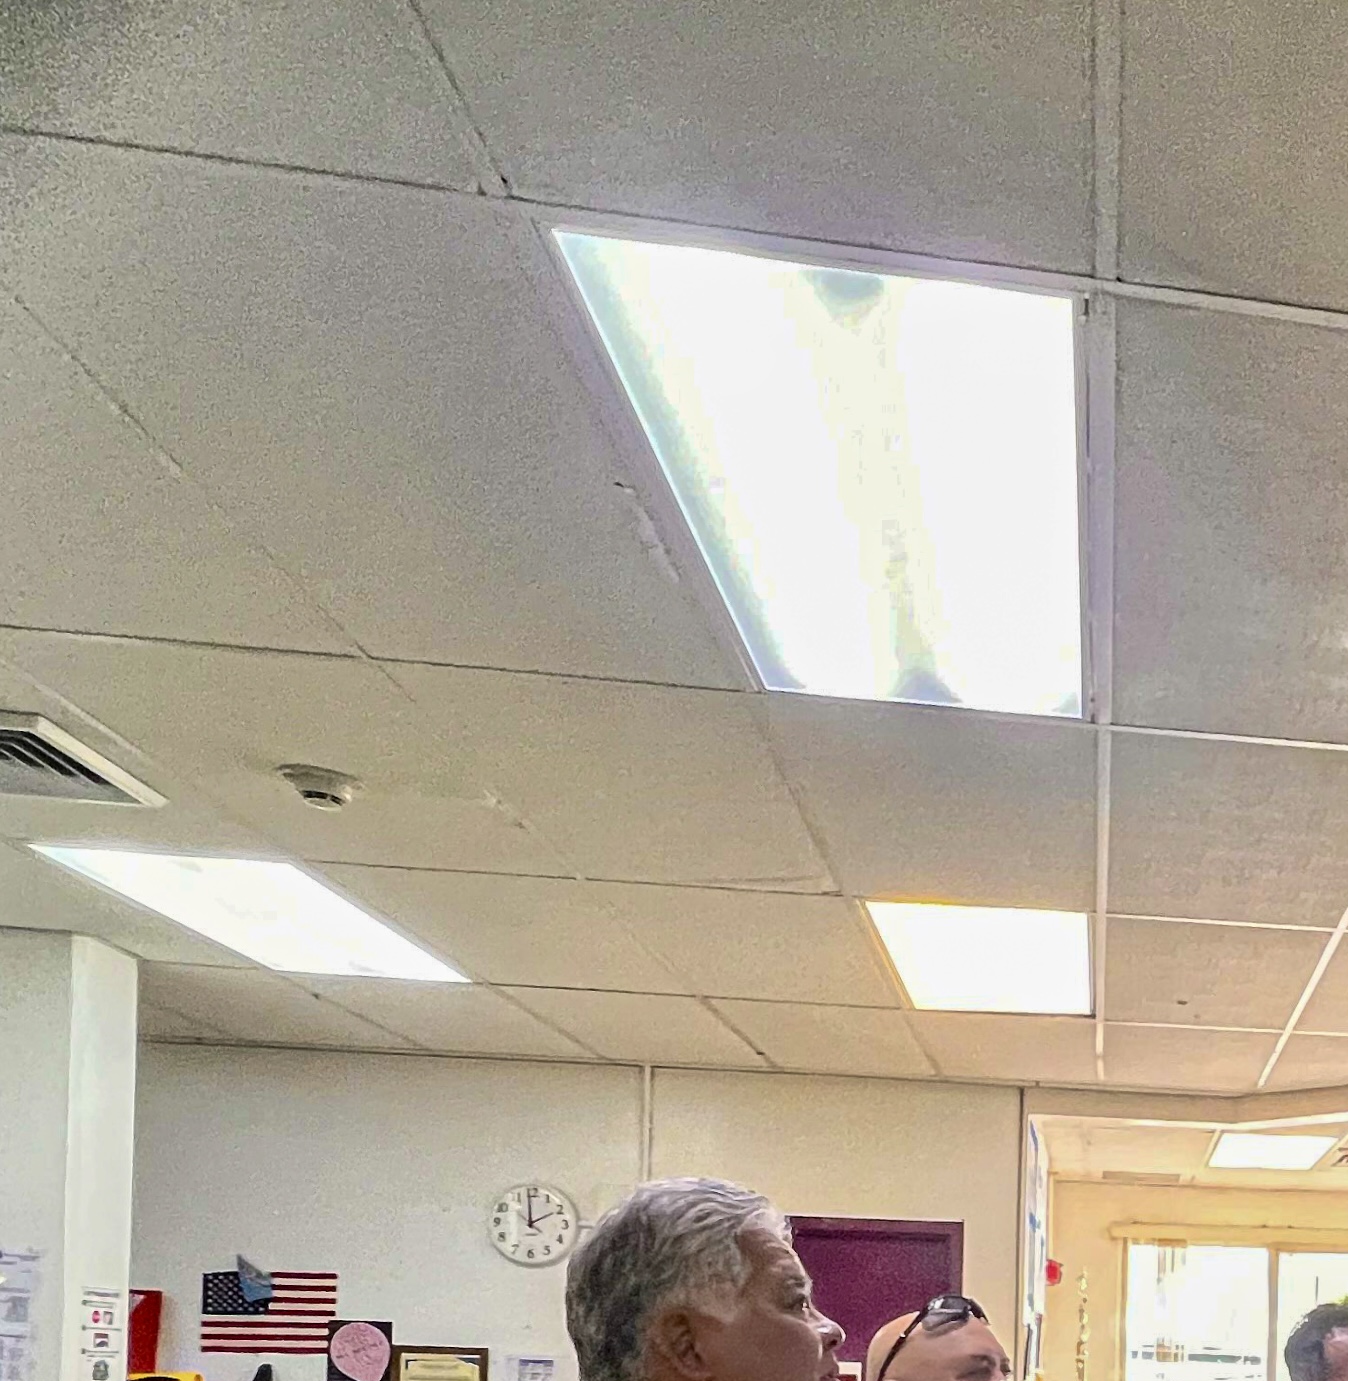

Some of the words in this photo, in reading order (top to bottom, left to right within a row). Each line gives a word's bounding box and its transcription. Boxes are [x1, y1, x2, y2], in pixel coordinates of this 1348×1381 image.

[545, 1194, 550, 1203] 1
[556, 1204, 564, 1215] 2
[493, 1217, 501, 1228] 9
[561, 1219, 569, 1230] 3
[498, 1232, 506, 1242] 8
[556, 1234, 563, 1244] 4
[511, 1243, 520, 1254] 7
[543, 1245, 551, 1255] 5
[527, 1249, 535, 1259] 6
